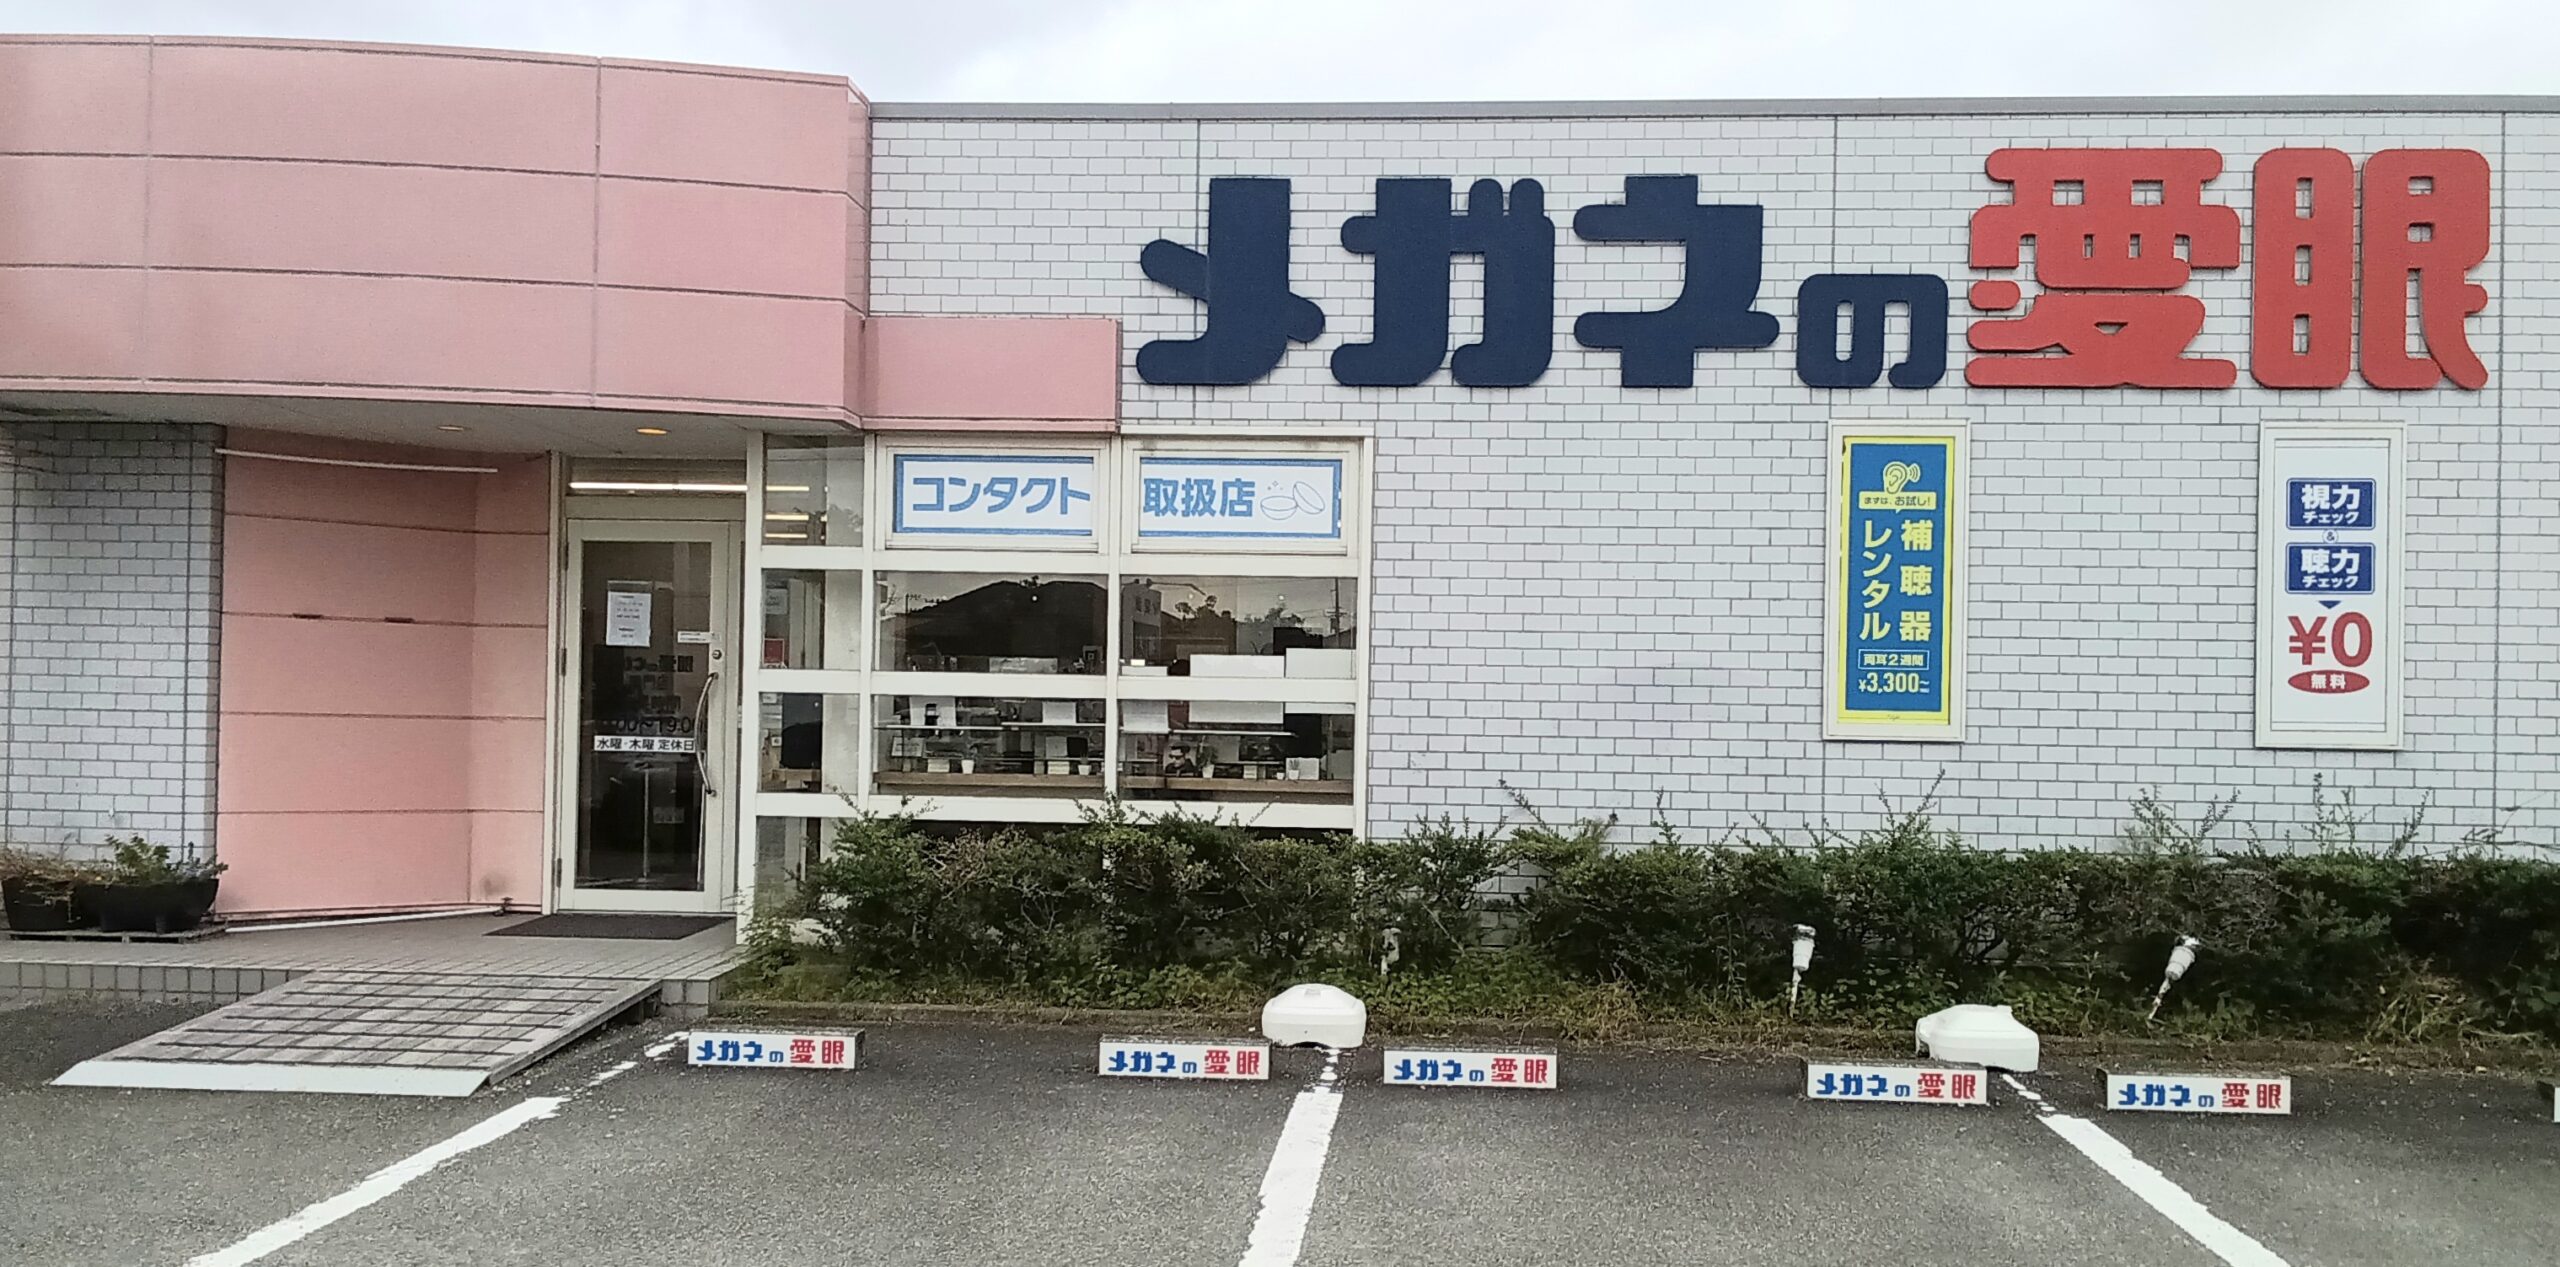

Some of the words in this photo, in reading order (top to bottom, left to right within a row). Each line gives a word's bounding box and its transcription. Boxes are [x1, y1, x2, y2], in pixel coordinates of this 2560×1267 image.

[1136, 148, 2490, 390] メガネの愛眼
[912, 476, 1092, 515] コンタクト
[1143, 477, 1256, 518] 取扱店
[2301, 484, 2361, 511] 視力
[2302, 511, 2360, 525] チェック
[2326, 531, 2336, 542] &
[2301, 548, 2360, 575] 聴力
[1859, 520, 1893, 641] レンタル
[1899, 519, 1933, 642] 補聴器
[2302, 575, 2360, 589] チェック
[2287, 611, 2373, 668] ¥0
[1863, 653, 1924, 667] 両耳2週間
[2310, 674, 2346, 690] 無料
[696, 1039, 845, 1065] メガネの愛眼
[1107, 1049, 1260, 1075] メガネの愛眼
[1393, 1057, 1548, 1083] メガネの愛眼
[1816, 1072, 1977, 1099] メガネの愛眼
[2118, 1082, 2281, 1109] メガネの愛眼
